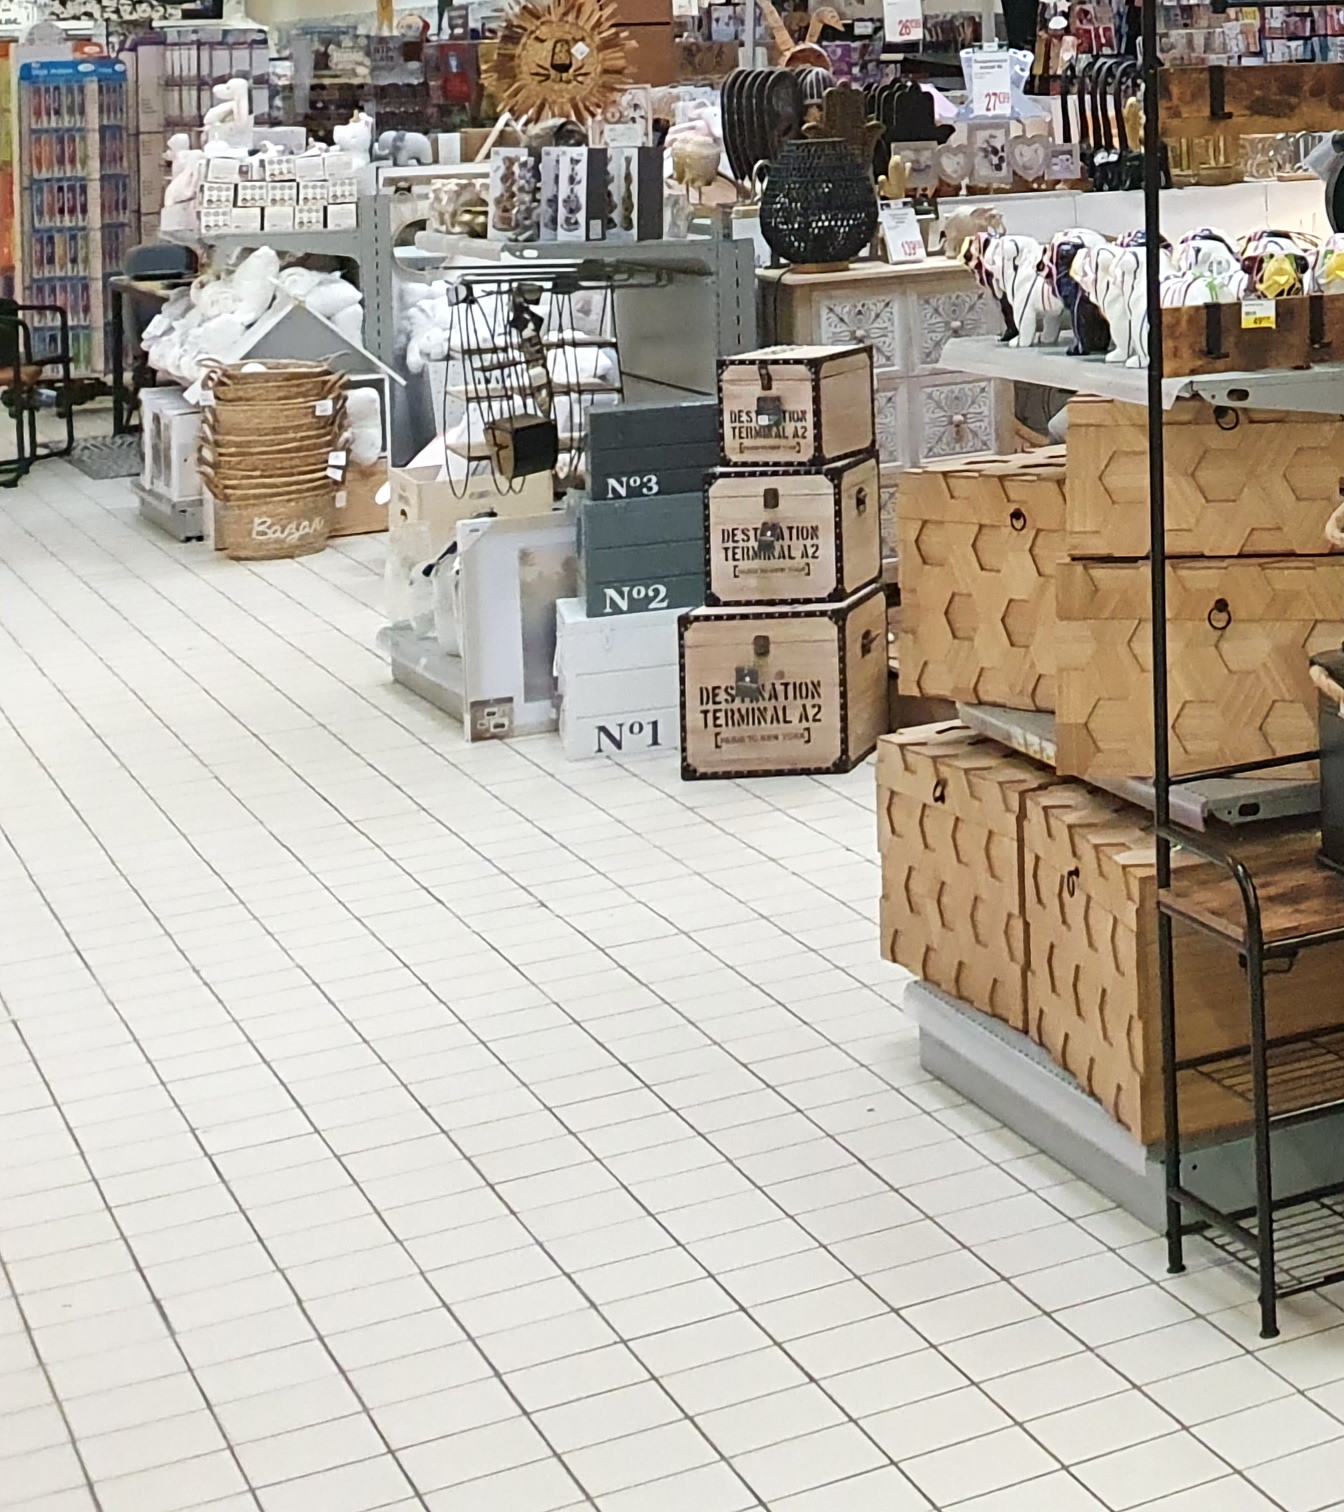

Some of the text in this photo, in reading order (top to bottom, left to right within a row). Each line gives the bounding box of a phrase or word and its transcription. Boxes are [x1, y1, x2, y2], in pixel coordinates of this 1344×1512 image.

[730, 409, 807, 424] DESTTION
[792, 425, 808, 439] A2
[721, 525, 820, 544] DESTATION
[801, 543, 820, 560] A2
[700, 703, 822, 729] TERMINAL A2
